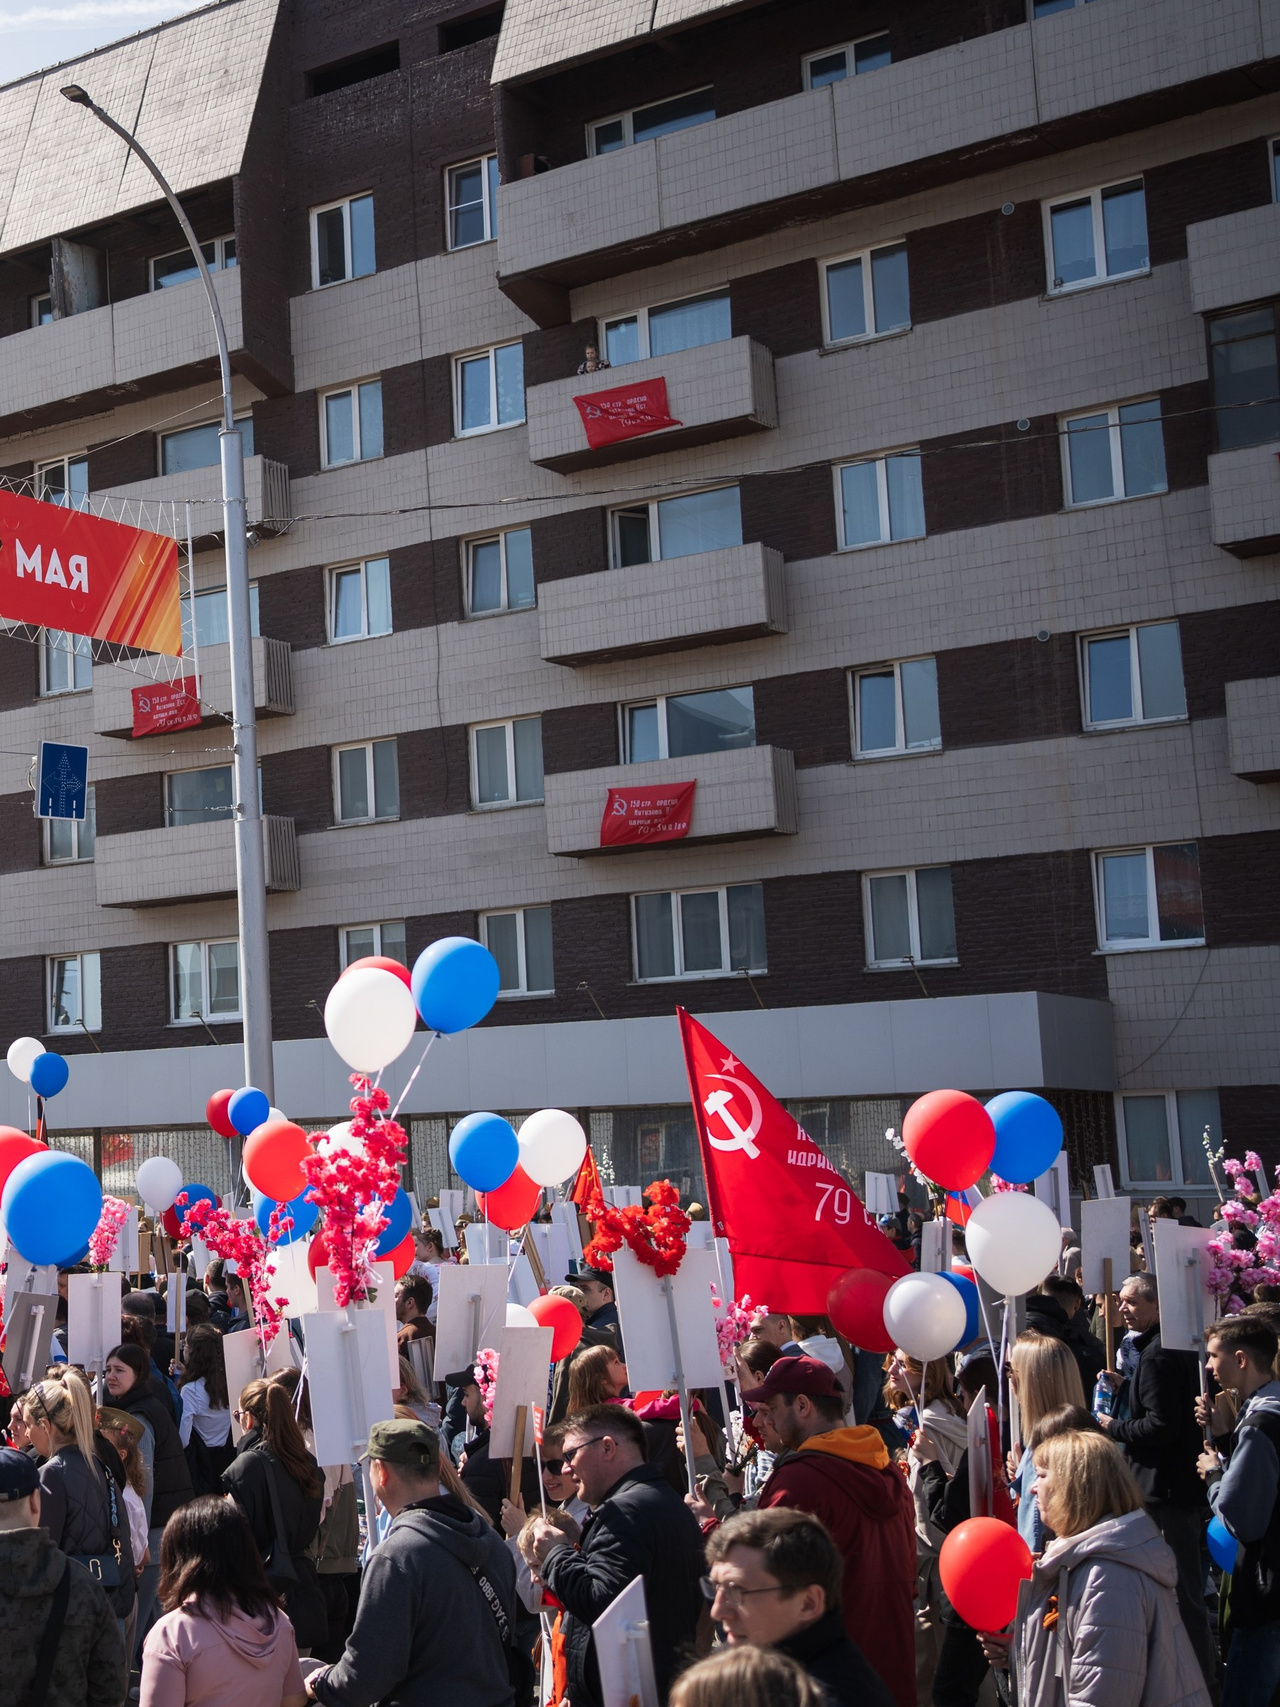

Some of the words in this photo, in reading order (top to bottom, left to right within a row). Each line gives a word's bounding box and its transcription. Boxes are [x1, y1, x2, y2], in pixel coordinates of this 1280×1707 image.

[15, 538, 89, 594] МАЯ
[787, 1149, 841, 1176] ИДРИЦ
[814, 1181, 851, 1225] 79
